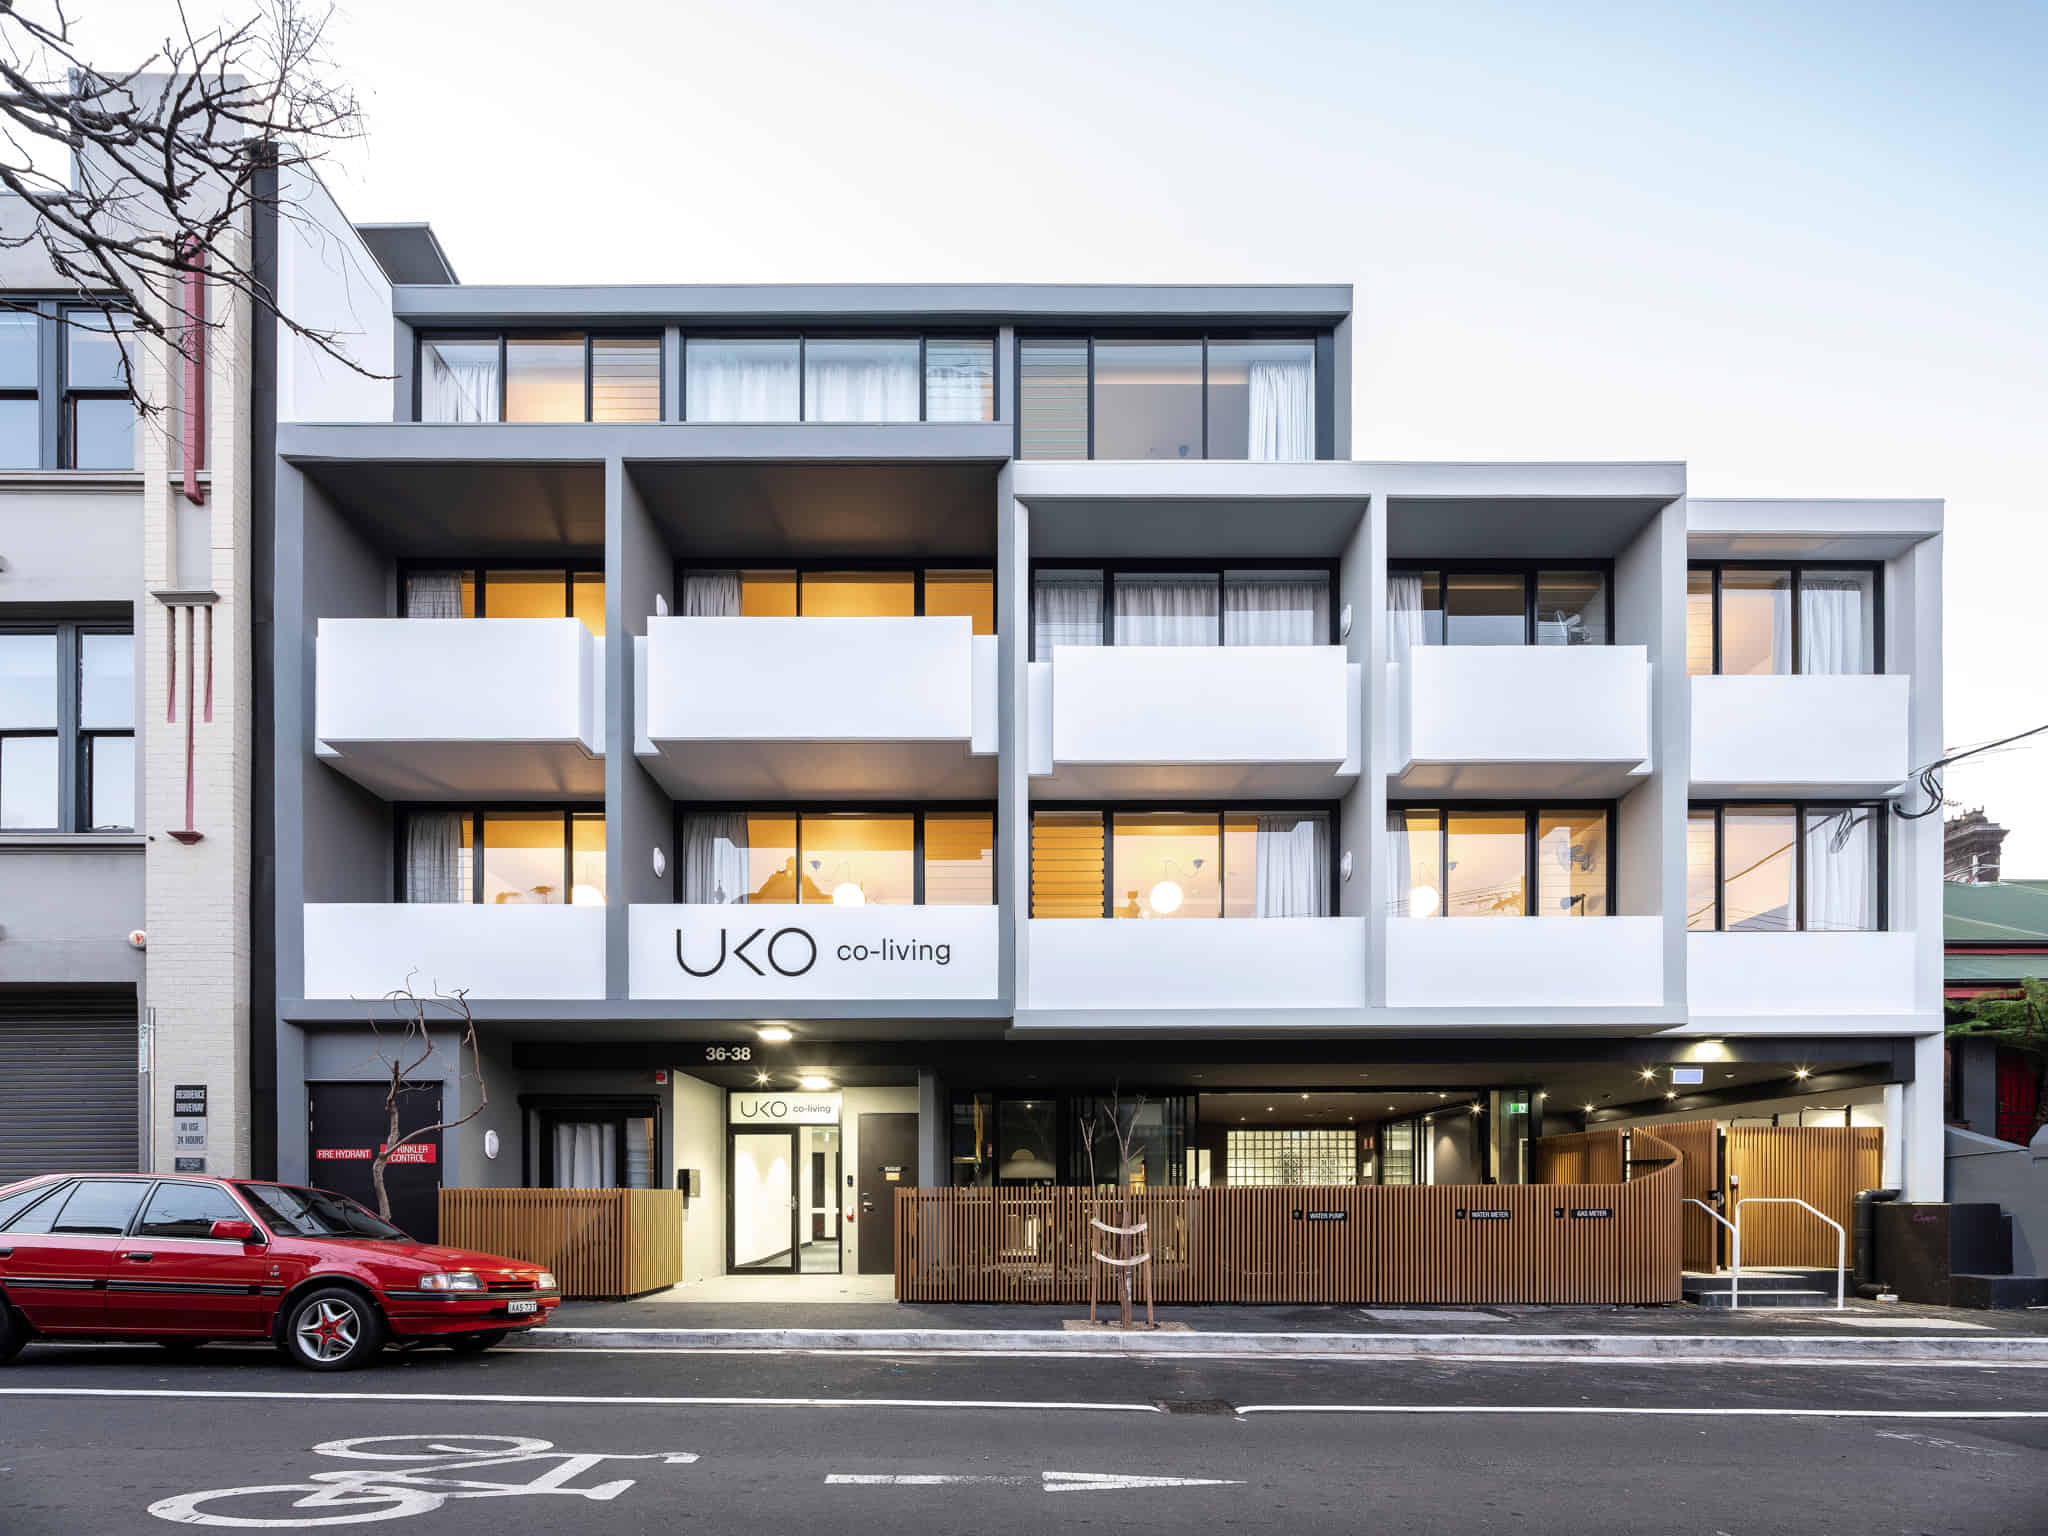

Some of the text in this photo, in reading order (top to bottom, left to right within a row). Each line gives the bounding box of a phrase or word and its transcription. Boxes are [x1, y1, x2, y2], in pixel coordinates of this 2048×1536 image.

[676, 927, 951, 977] UKO co-living
[705, 1047, 751, 1061] 36-38
[175, 1103, 204, 1113] DRIVEWAY
[740, 1100, 831, 1118] UKO co-living
[185, 1135, 204, 1144] HOURS
[318, 1150, 369, 1158] FIRE HYDRANT
[391, 1153, 426, 1162] CONTROL
